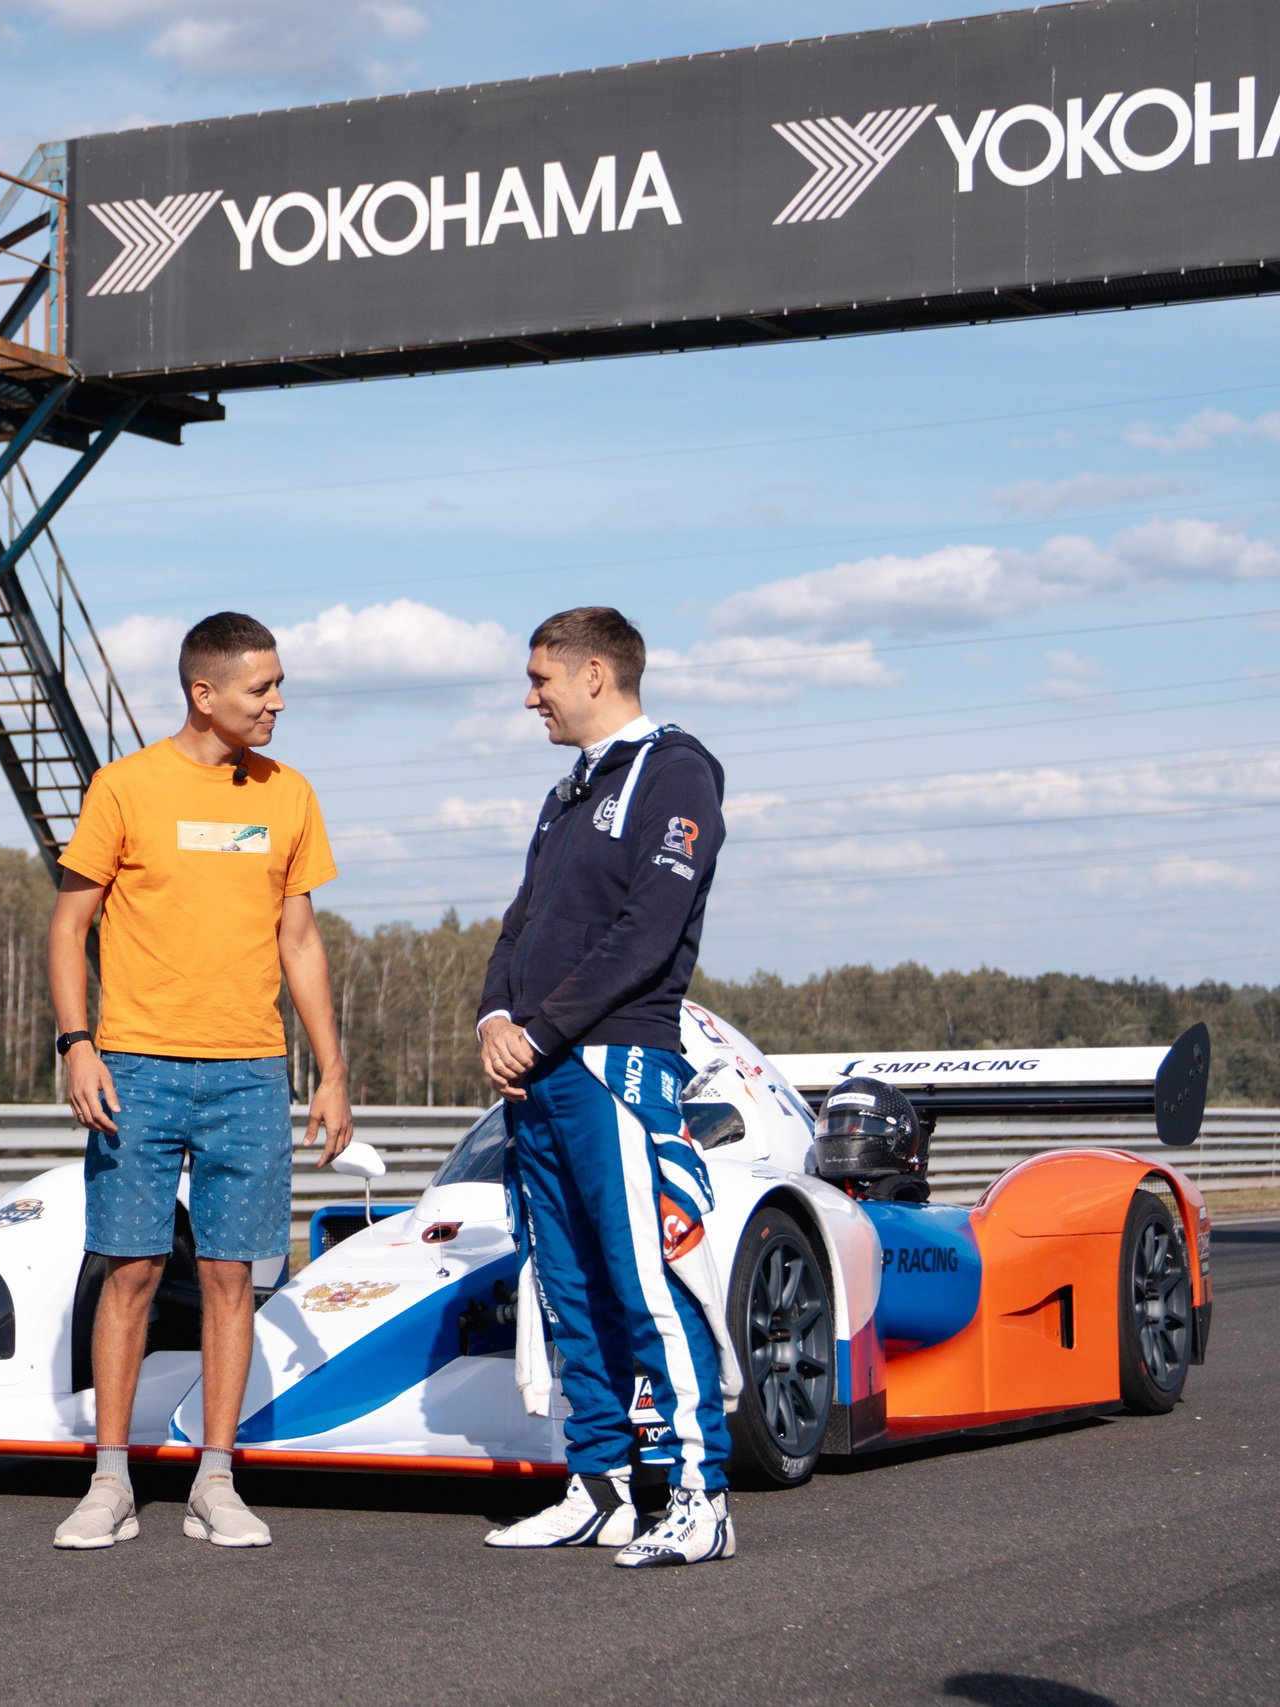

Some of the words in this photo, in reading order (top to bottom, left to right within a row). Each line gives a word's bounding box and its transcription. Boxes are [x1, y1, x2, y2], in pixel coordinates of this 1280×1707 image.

[222, 151, 682, 271] YOKOHAMA
[624, 1045, 644, 1105] ACING
[868, 1062, 931, 1074] SMP
[932, 1059, 1040, 1073] RACING
[897, 1246, 958, 1274] RACING
